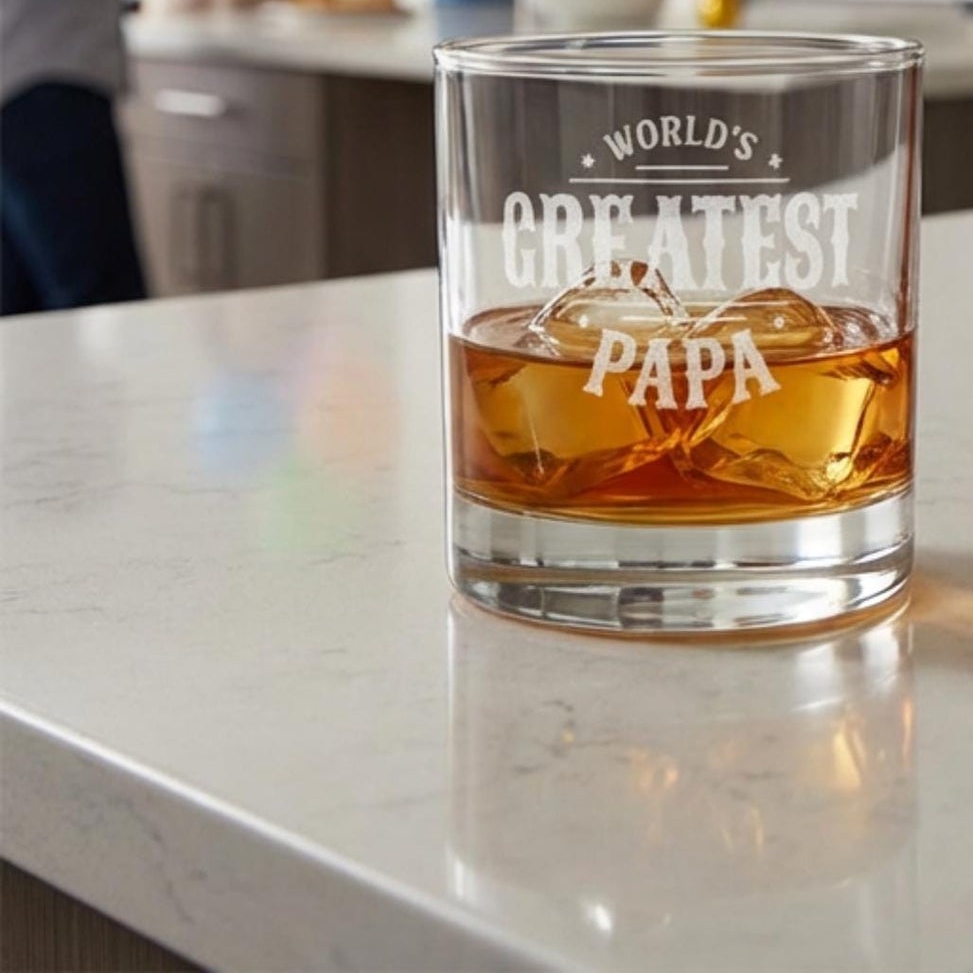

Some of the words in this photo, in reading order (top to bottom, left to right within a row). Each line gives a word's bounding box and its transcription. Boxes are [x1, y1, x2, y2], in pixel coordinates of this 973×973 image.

[603, 115, 759, 161] WORLD'S
[502, 191, 858, 290] GREATEST
[582, 328, 781, 410] PAPA
